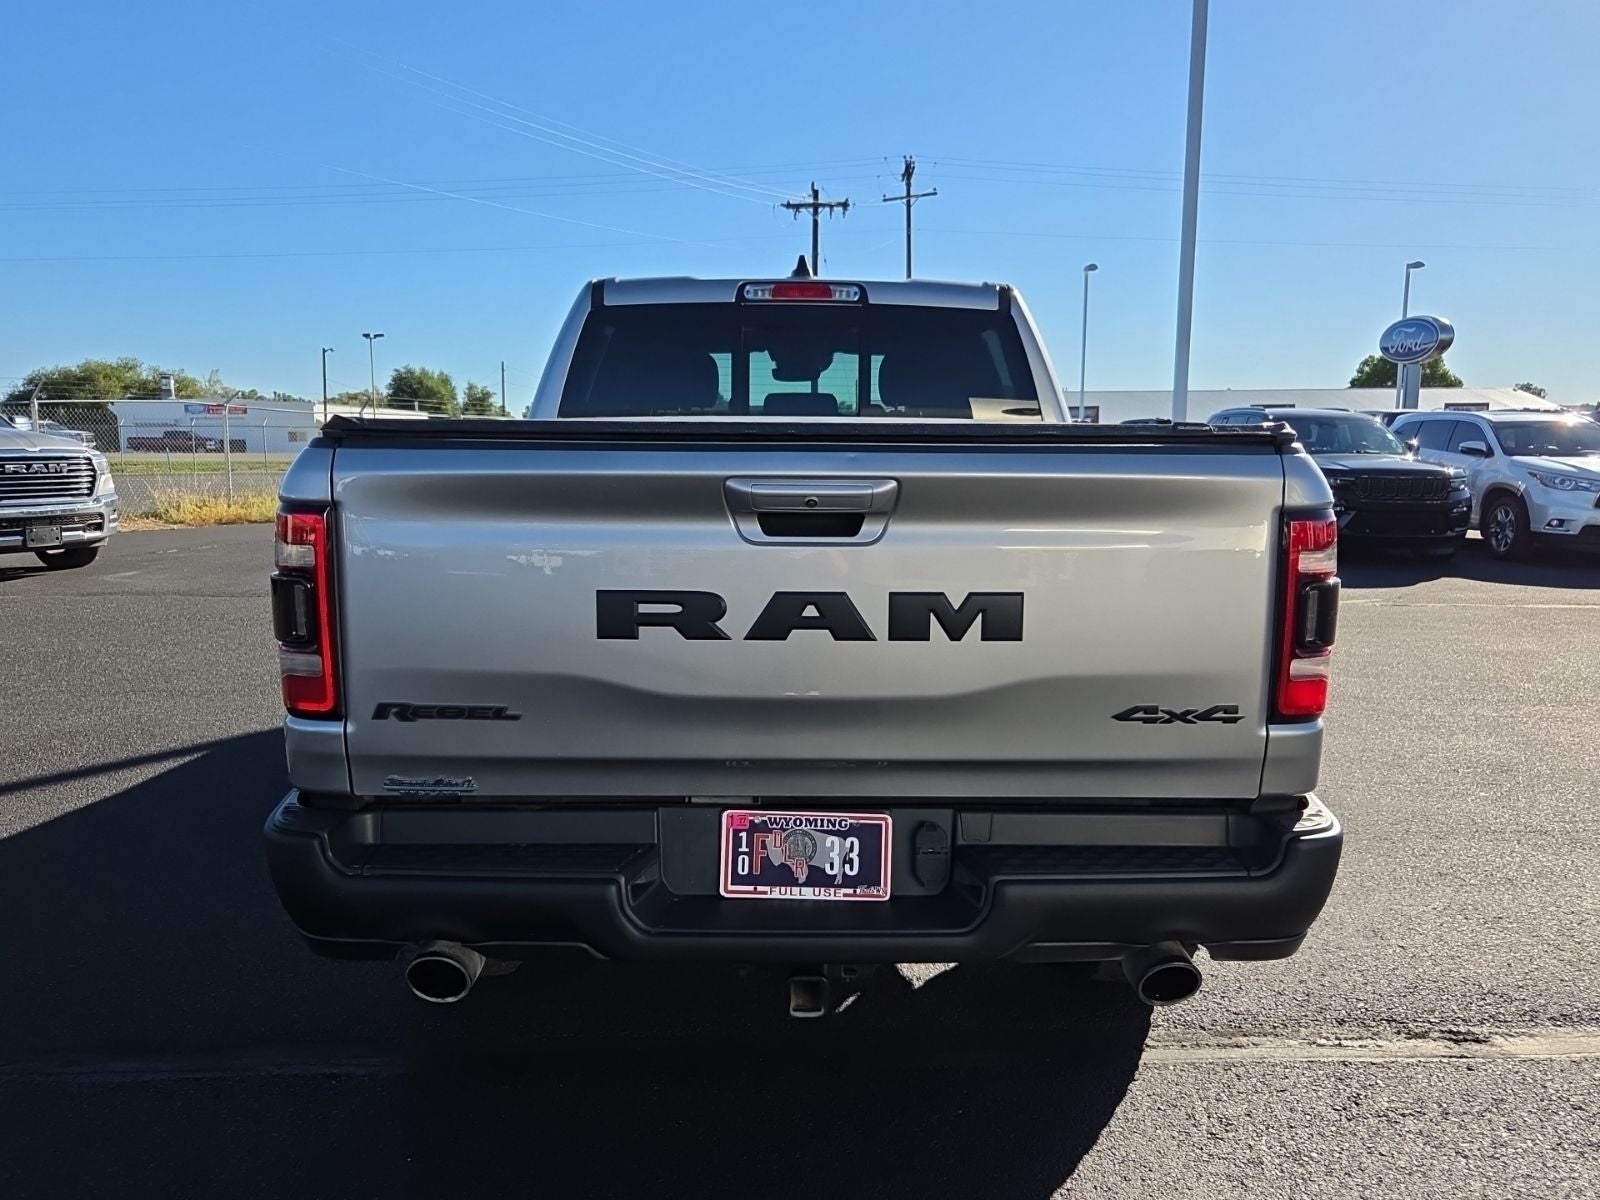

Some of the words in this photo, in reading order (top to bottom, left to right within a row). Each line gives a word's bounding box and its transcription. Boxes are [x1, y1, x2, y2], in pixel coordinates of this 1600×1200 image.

[1387, 326, 1430, 354] Ford
[4, 463, 68, 474] RAM
[596, 588, 1024, 642] RAM
[372, 702, 522, 723] REBEL
[1111, 704, 1245, 725] 4x4
[766, 815, 850, 831] WYOMING
[824, 835, 860, 876] 33
[768, 886, 807, 897] FULL
[812, 887, 843, 898] USE
